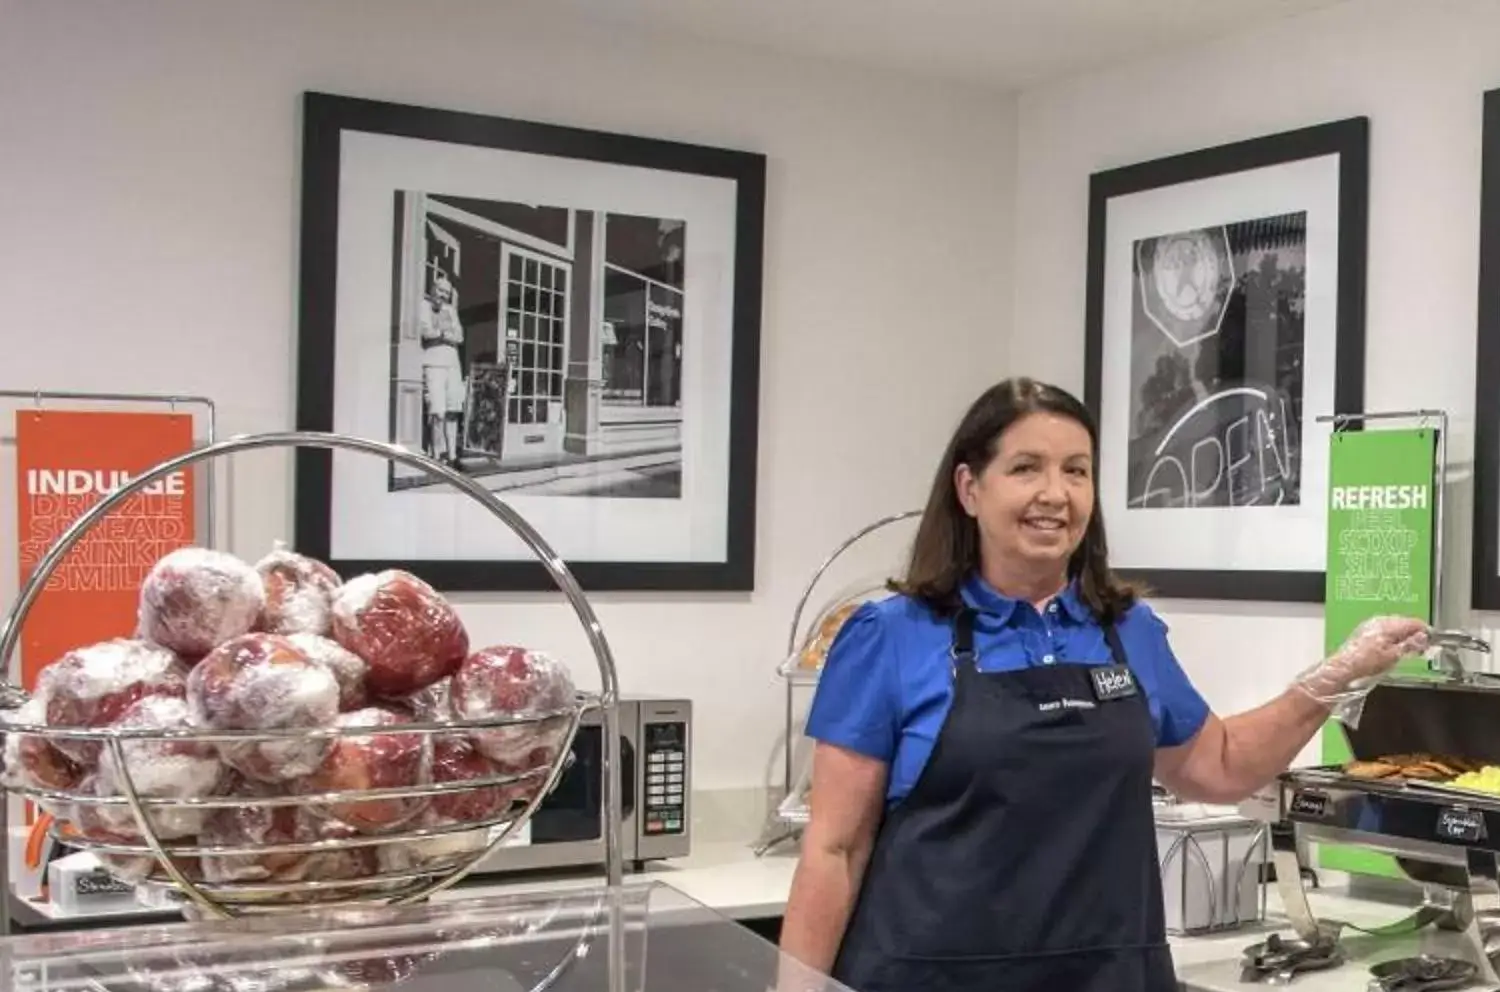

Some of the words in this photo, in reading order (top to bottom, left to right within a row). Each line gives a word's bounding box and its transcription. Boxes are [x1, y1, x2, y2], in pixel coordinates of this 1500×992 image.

[1332, 485, 1427, 510] REFRESH
[1338, 529, 1419, 555] SCOOP
[1343, 554, 1411, 578] SLICE
